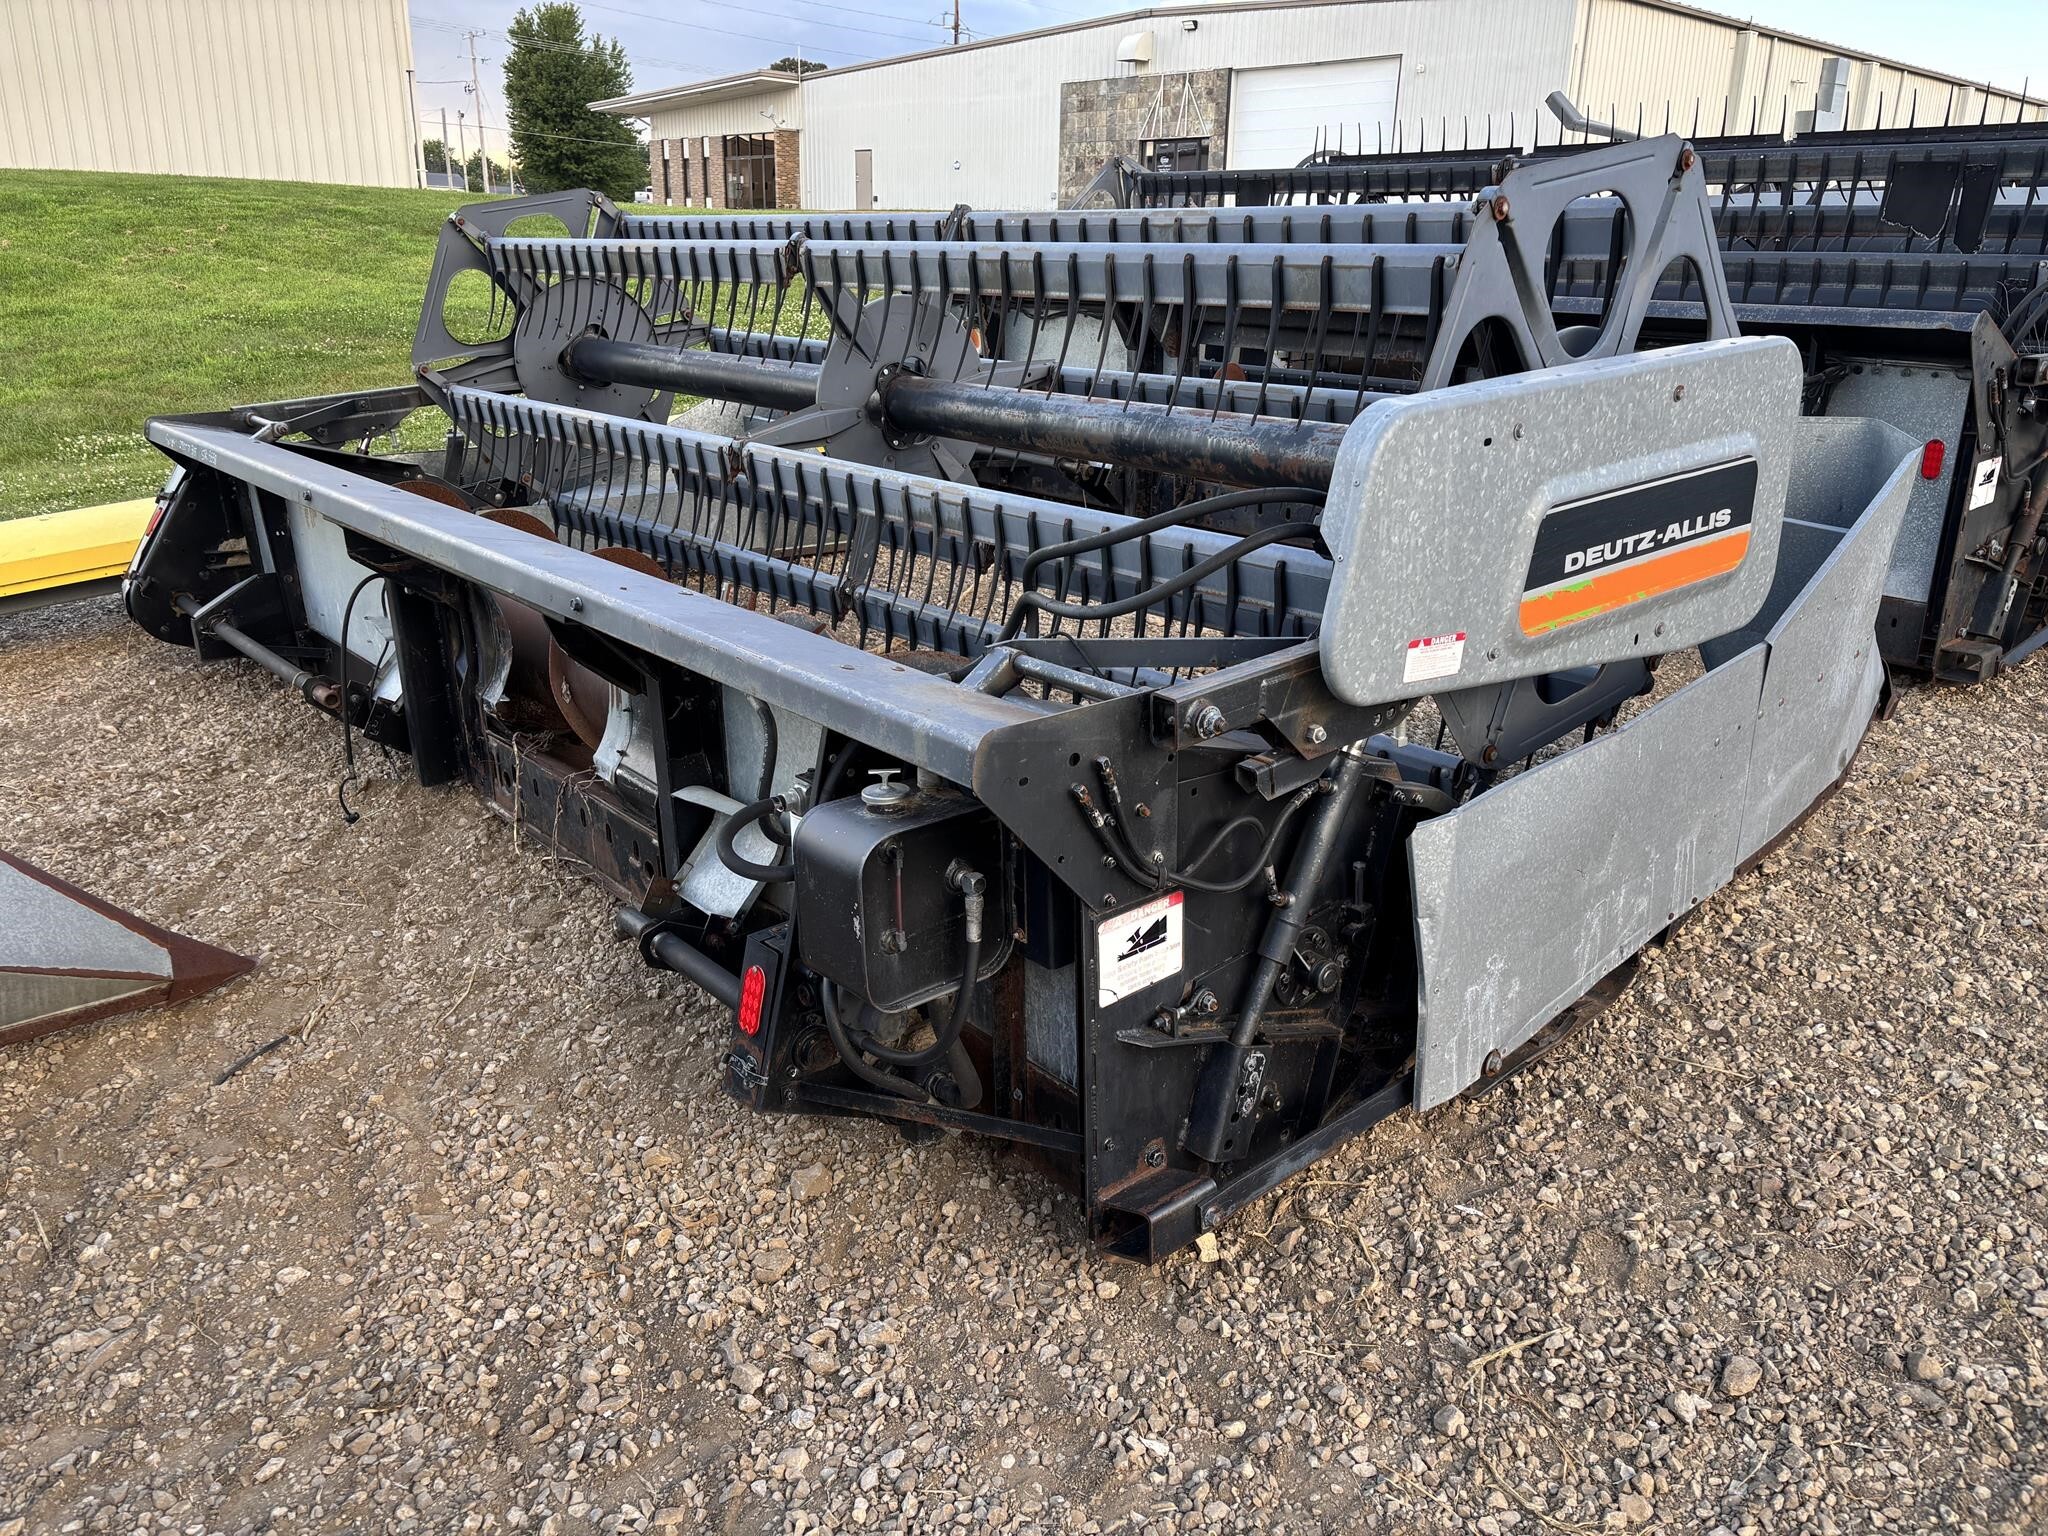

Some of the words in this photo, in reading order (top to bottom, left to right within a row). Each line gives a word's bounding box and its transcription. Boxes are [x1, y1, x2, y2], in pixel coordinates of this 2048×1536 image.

[1563, 508, 1732, 574] DEUTZ-ALLIS
[1431, 634, 1457, 645] DANGER
[1130, 898, 1170, 922] DANGER
